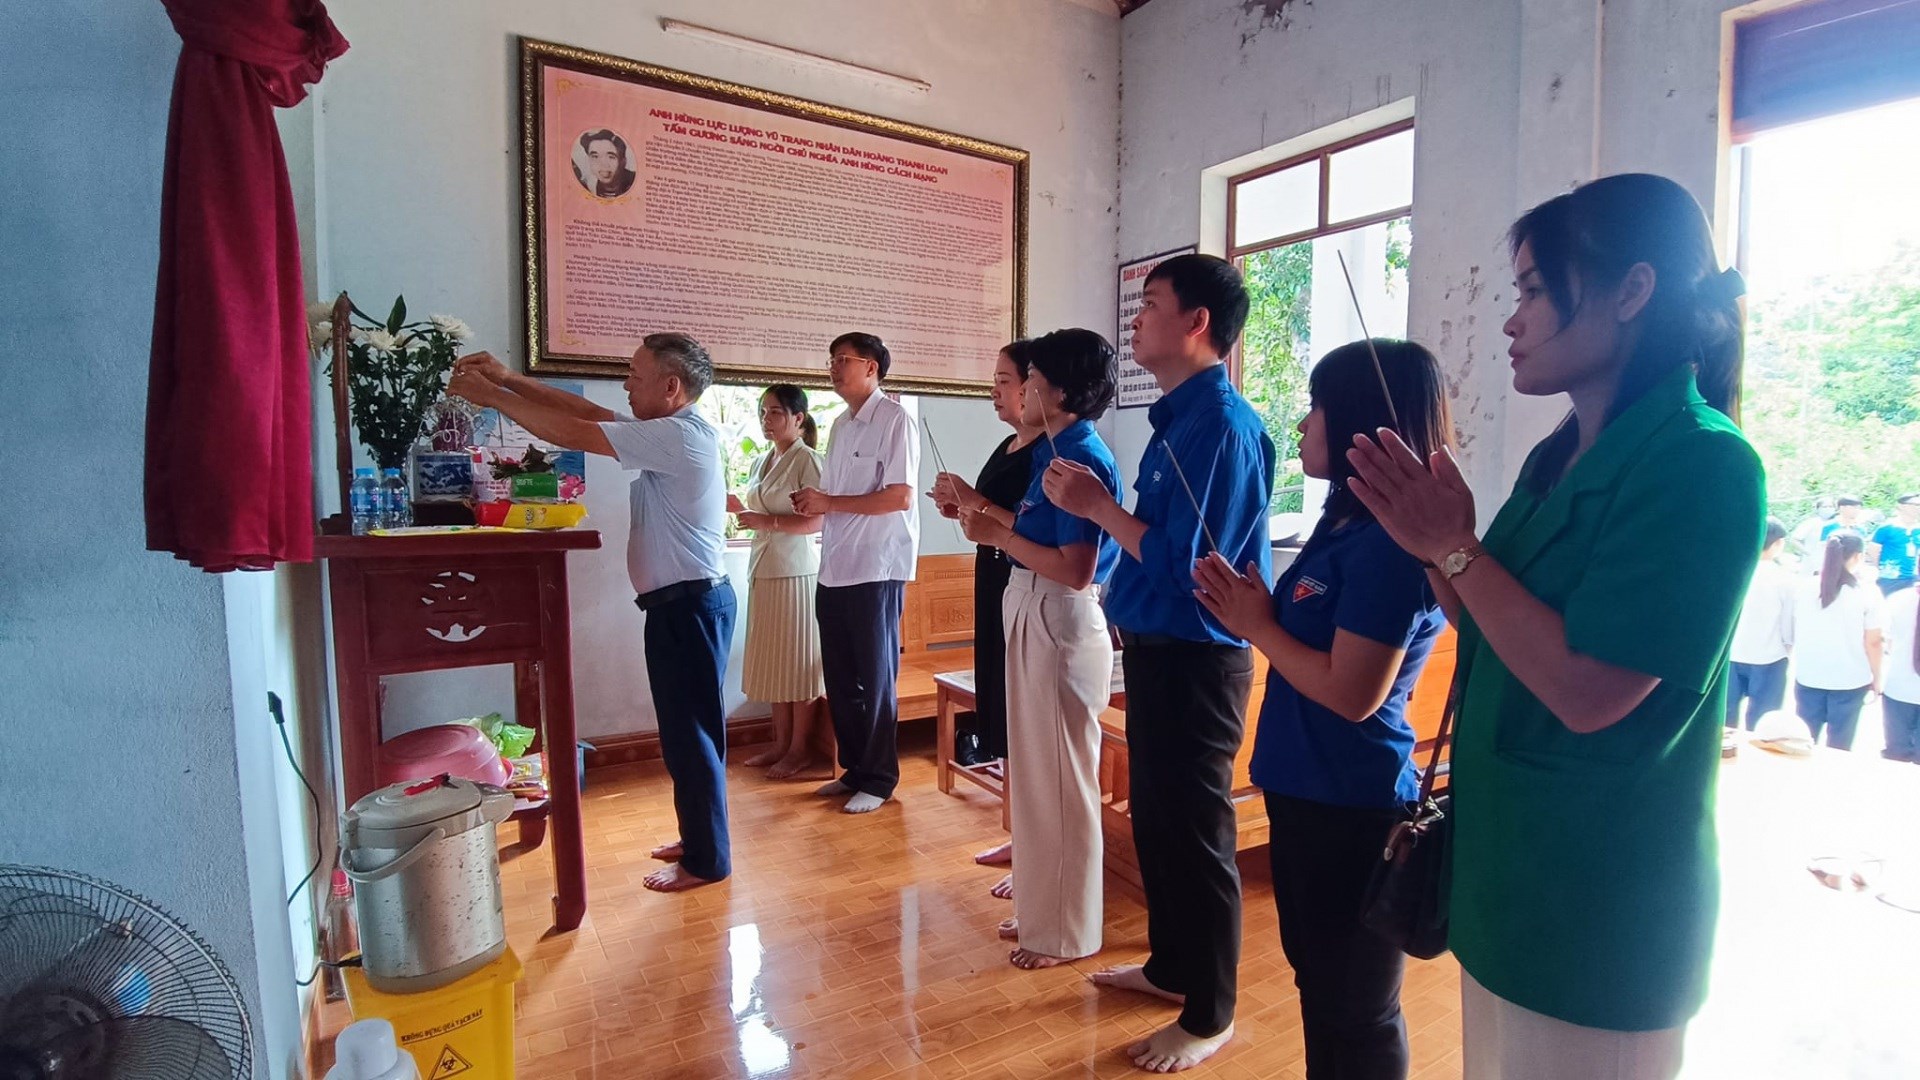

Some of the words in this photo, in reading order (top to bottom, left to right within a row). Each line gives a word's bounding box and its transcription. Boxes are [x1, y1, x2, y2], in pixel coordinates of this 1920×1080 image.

[649, 108, 672, 120] ANH
[674, 112, 704, 126] HÙNG
[707, 119, 727, 131] LỰC
[729, 123, 762, 138] LƯỢNG
[781, 134, 814, 148] TRANG
[842, 144, 862, 157] DÂN
[863, 150, 894, 164] HOÀNG
[896, 158, 924, 170] THANH
[926, 164, 948, 175] LOAN
[663, 122, 686, 135] TẤM
[689, 128, 728, 142] GƯƠNG
[730, 136, 758, 149] SÁNG
[760, 141, 784, 154] NGỜI
[787, 147, 807, 158] CHỦ
[809, 151, 838, 164] NGHĨA
[840, 158, 859, 168] ANH
[861, 161, 885, 173] HÙNG
[887, 165, 912, 178] CÁCH
